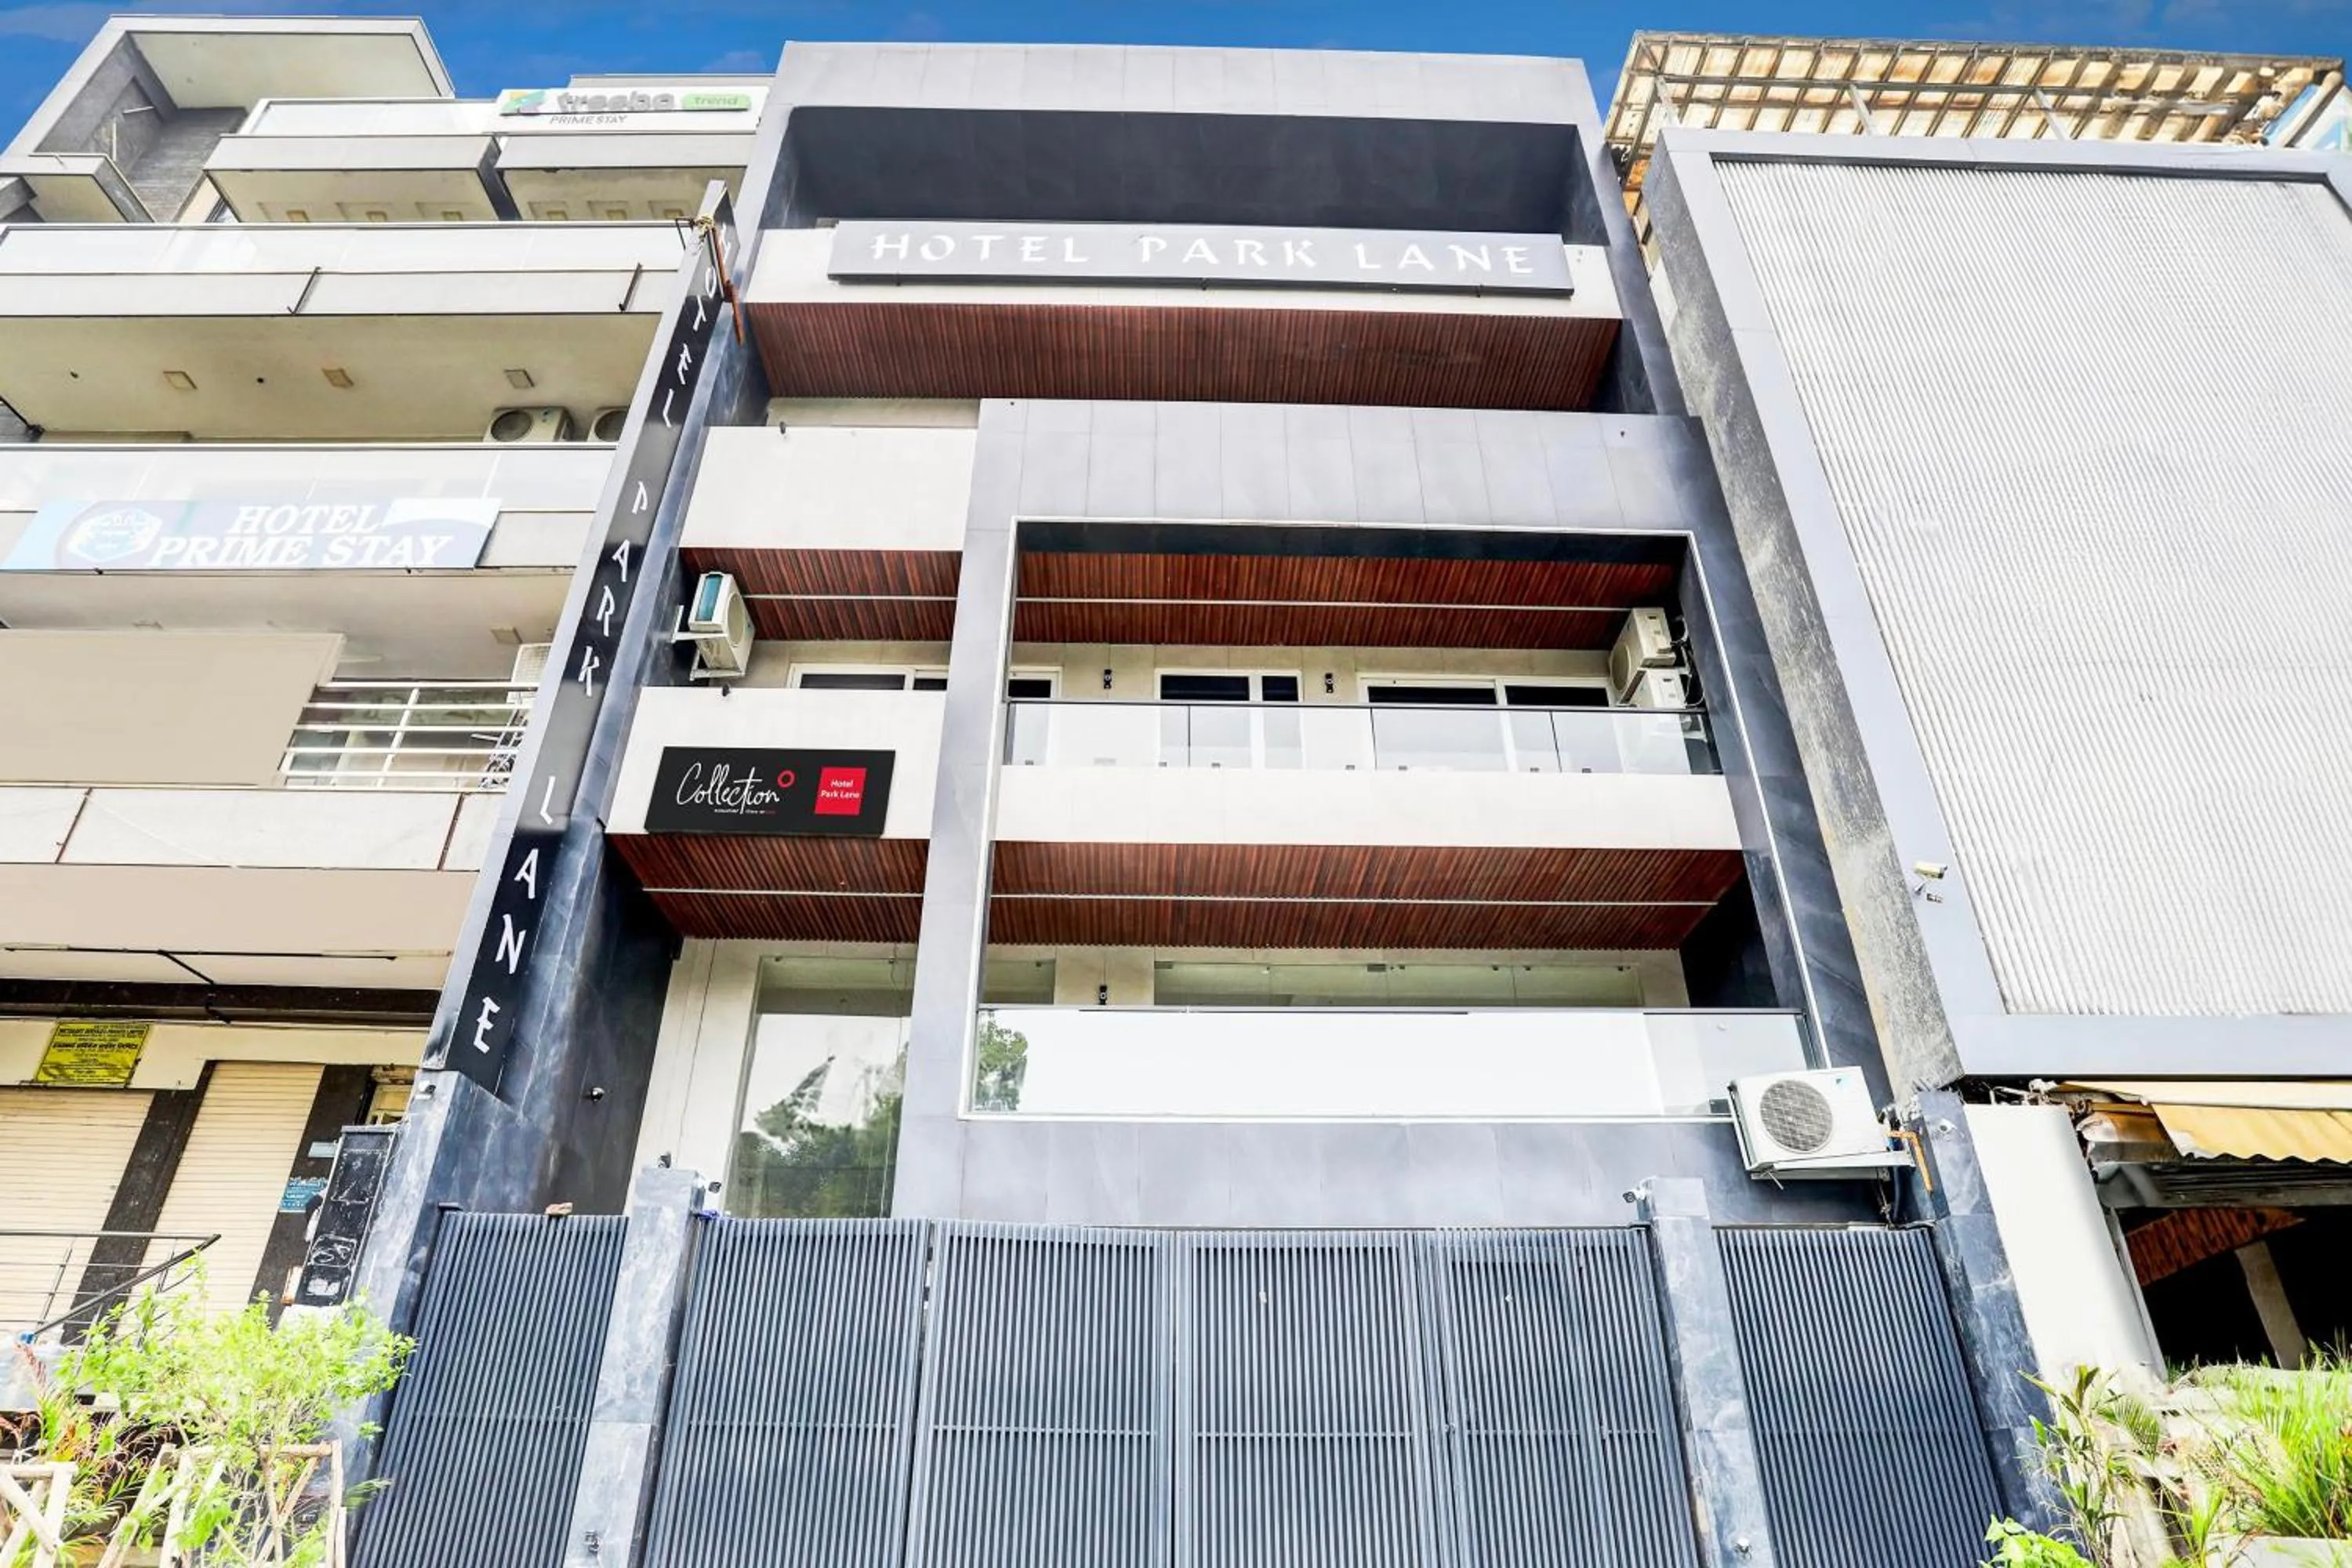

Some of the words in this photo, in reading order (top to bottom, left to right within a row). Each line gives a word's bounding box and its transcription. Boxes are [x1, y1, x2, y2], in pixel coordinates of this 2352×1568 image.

[693, 95, 739, 105] trend
[549, 115, 595, 124] PRIME
[596, 115, 627, 124] STAY
[871, 233, 1088, 264] HOTEL
[1138, 236, 1317, 268] PARK
[1356, 243, 1534, 275] LANE
[228, 506, 379, 534] HOTEL
[147, 537, 309, 565] PRIME
[322, 537, 451, 565] STAY
[576, 481, 648, 697] PARK
[676, 762, 780, 815] Collection
[820, 789, 838, 798] Park
[830, 779, 854, 788] Hotel
[473, 775, 555, 1054] LANE
